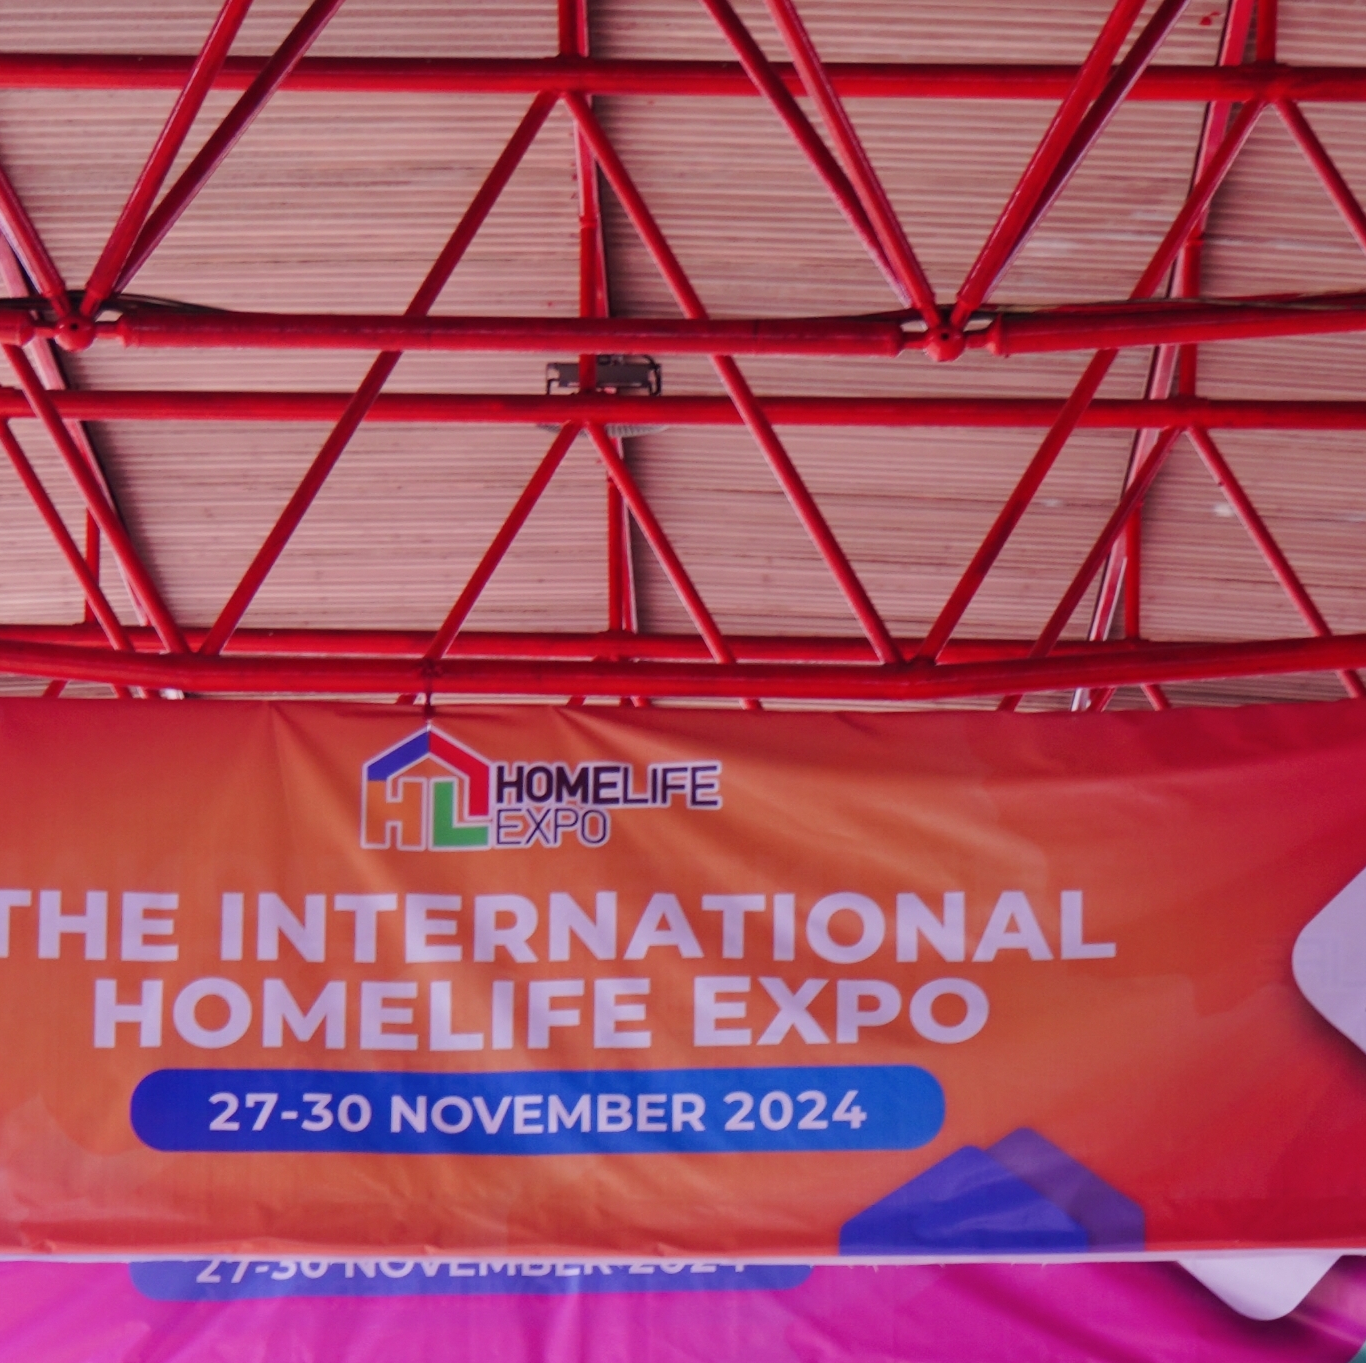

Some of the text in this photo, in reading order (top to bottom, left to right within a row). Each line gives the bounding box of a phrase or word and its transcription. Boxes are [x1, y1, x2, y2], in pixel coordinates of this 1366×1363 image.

[496, 763, 720, 807] HOMELIFE
[496, 808, 608, 847] EXPO
[220, 889, 1117, 964] INTERNATIONAL
[93, 975, 990, 1052] HOMELIFE EXPO
[208, 1090, 868, 1135] 27-30 NOVEMBER 2024
